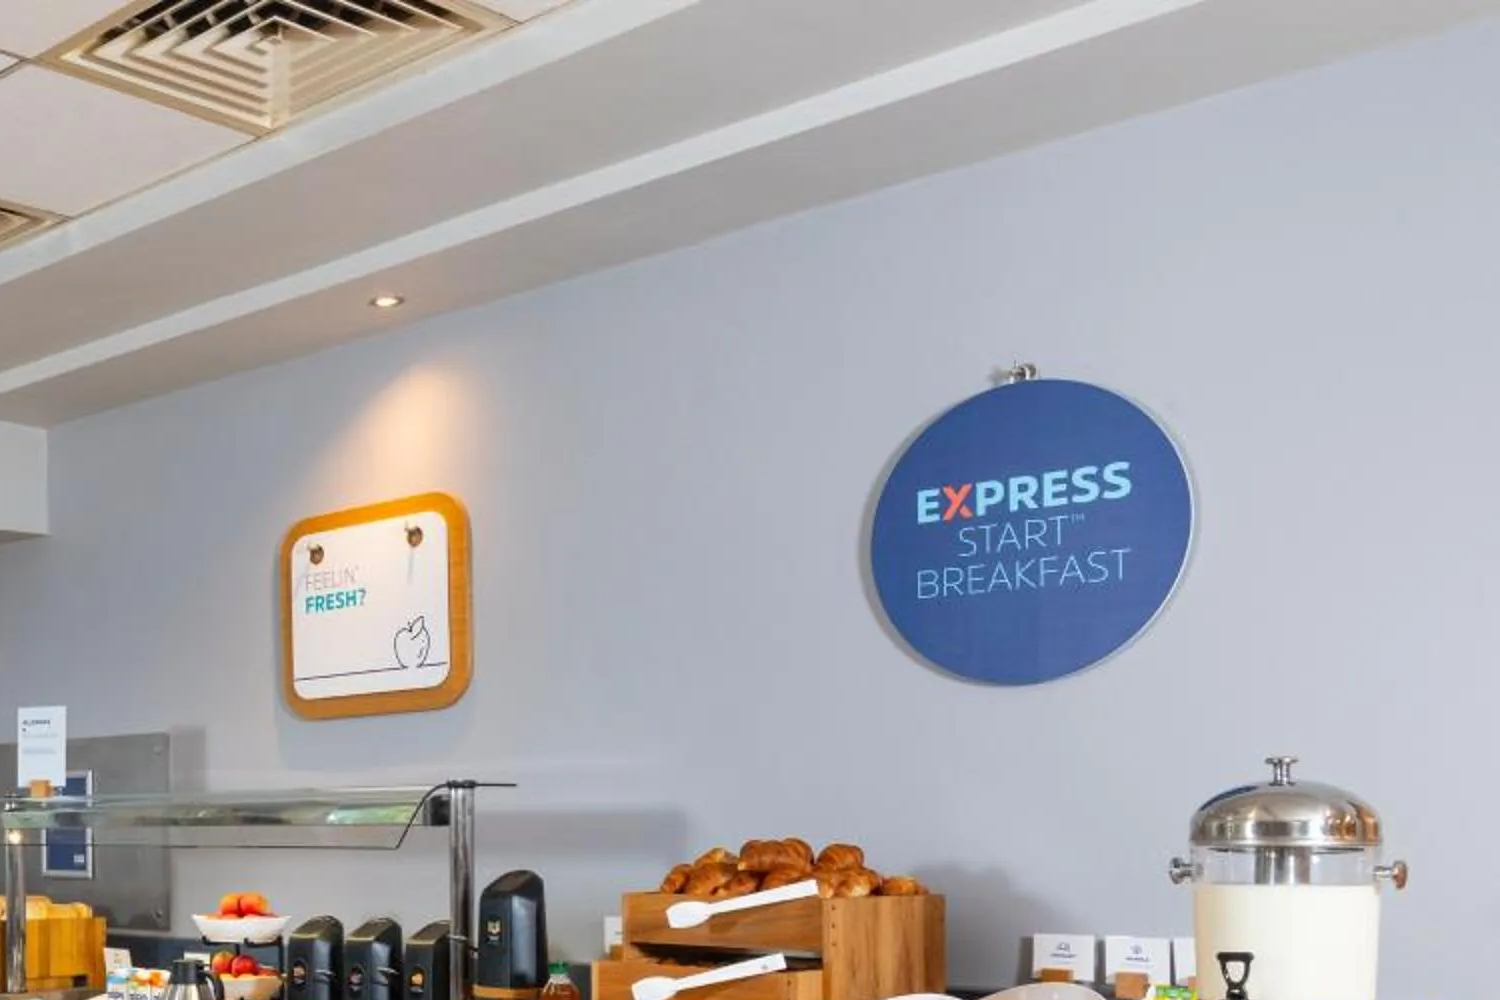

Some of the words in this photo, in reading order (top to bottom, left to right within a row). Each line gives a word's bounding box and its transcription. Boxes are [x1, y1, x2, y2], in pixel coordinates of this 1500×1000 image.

[916, 461, 1132, 524] EXPRESS
[916, 547, 1132, 600] BREAKFAST
[305, 588, 367, 615] FRESH?
